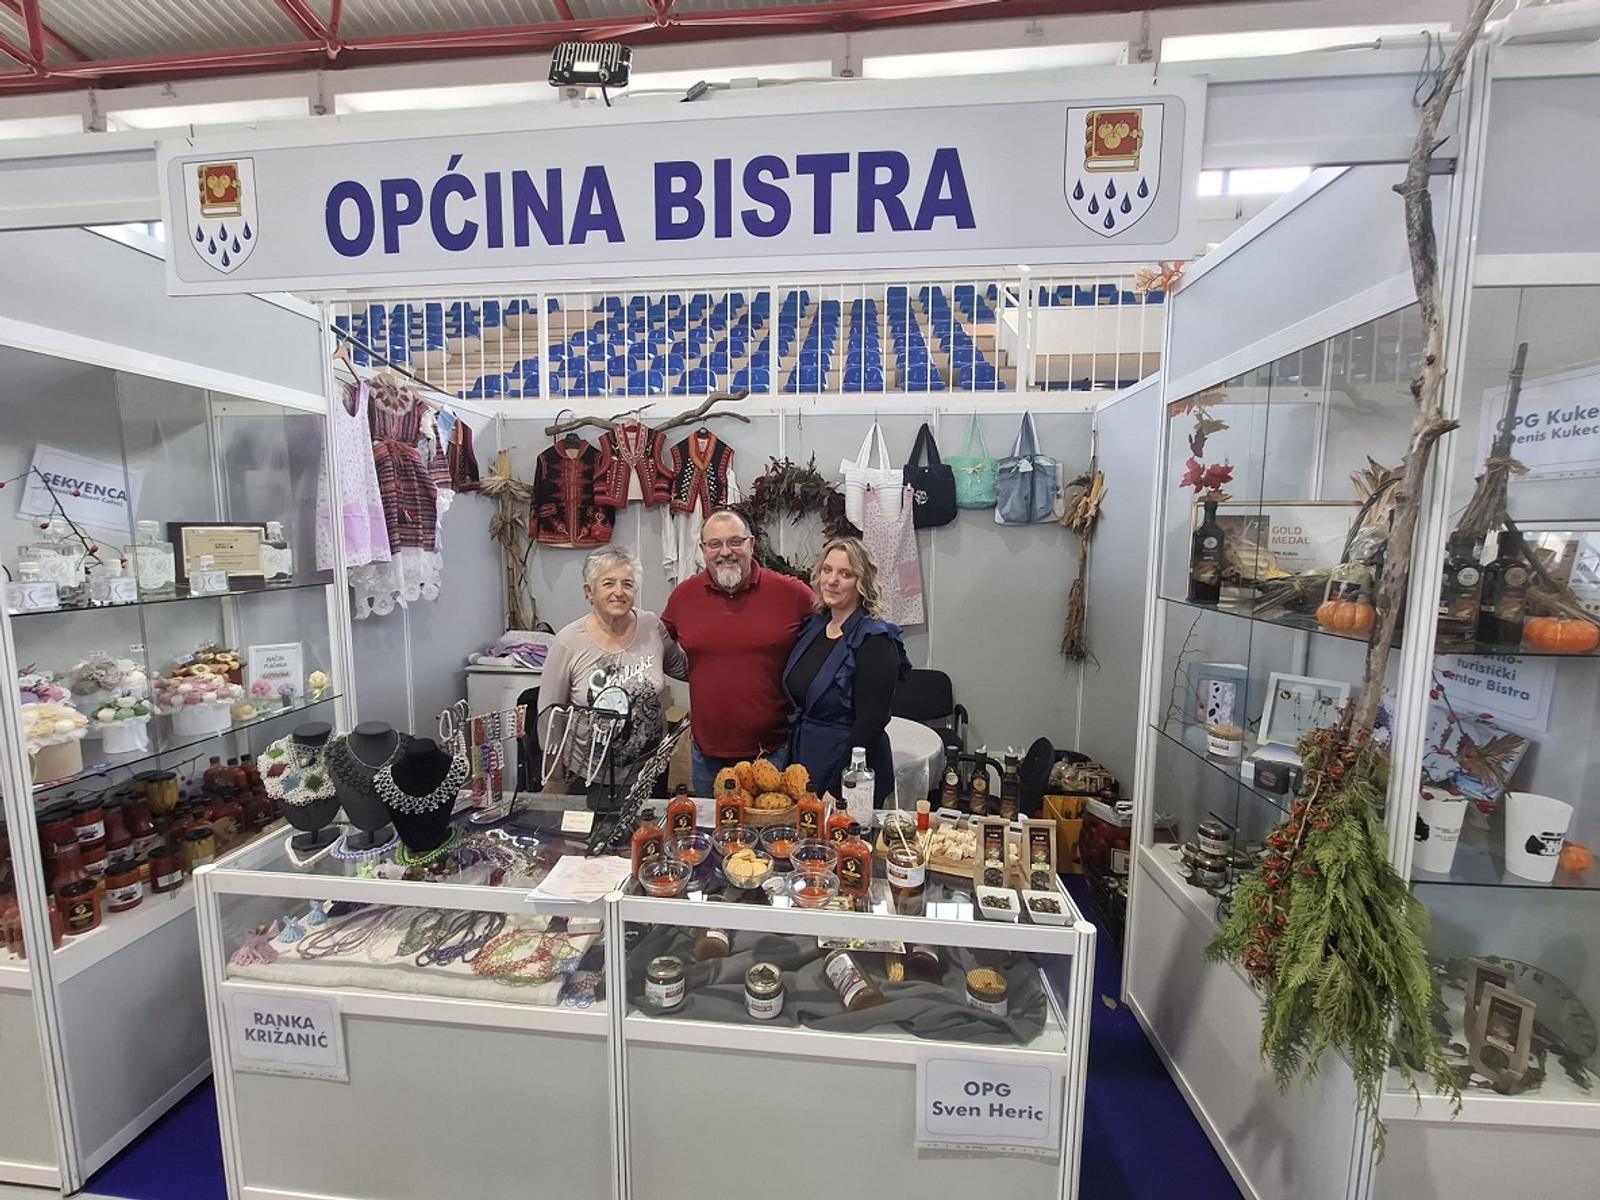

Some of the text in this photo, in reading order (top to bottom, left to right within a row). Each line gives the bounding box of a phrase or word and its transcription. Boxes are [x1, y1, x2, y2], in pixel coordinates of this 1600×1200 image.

[324, 146, 978, 257] OPĆINA BISTRA
[1511, 431, 1547, 444] enis
[43, 472, 127, 501] SEKVENCA
[1271, 525, 1303, 536] GOLD
[1271, 535, 1312, 545] MEDAL
[1449, 672, 1530, 701] entar Bistra
[253, 1012, 315, 1030] RANKA
[245, 1026, 329, 1048] KRIŽANIĆ
[964, 1080, 1011, 1098] OPG
[932, 1100, 1044, 1121] Sven Heric
